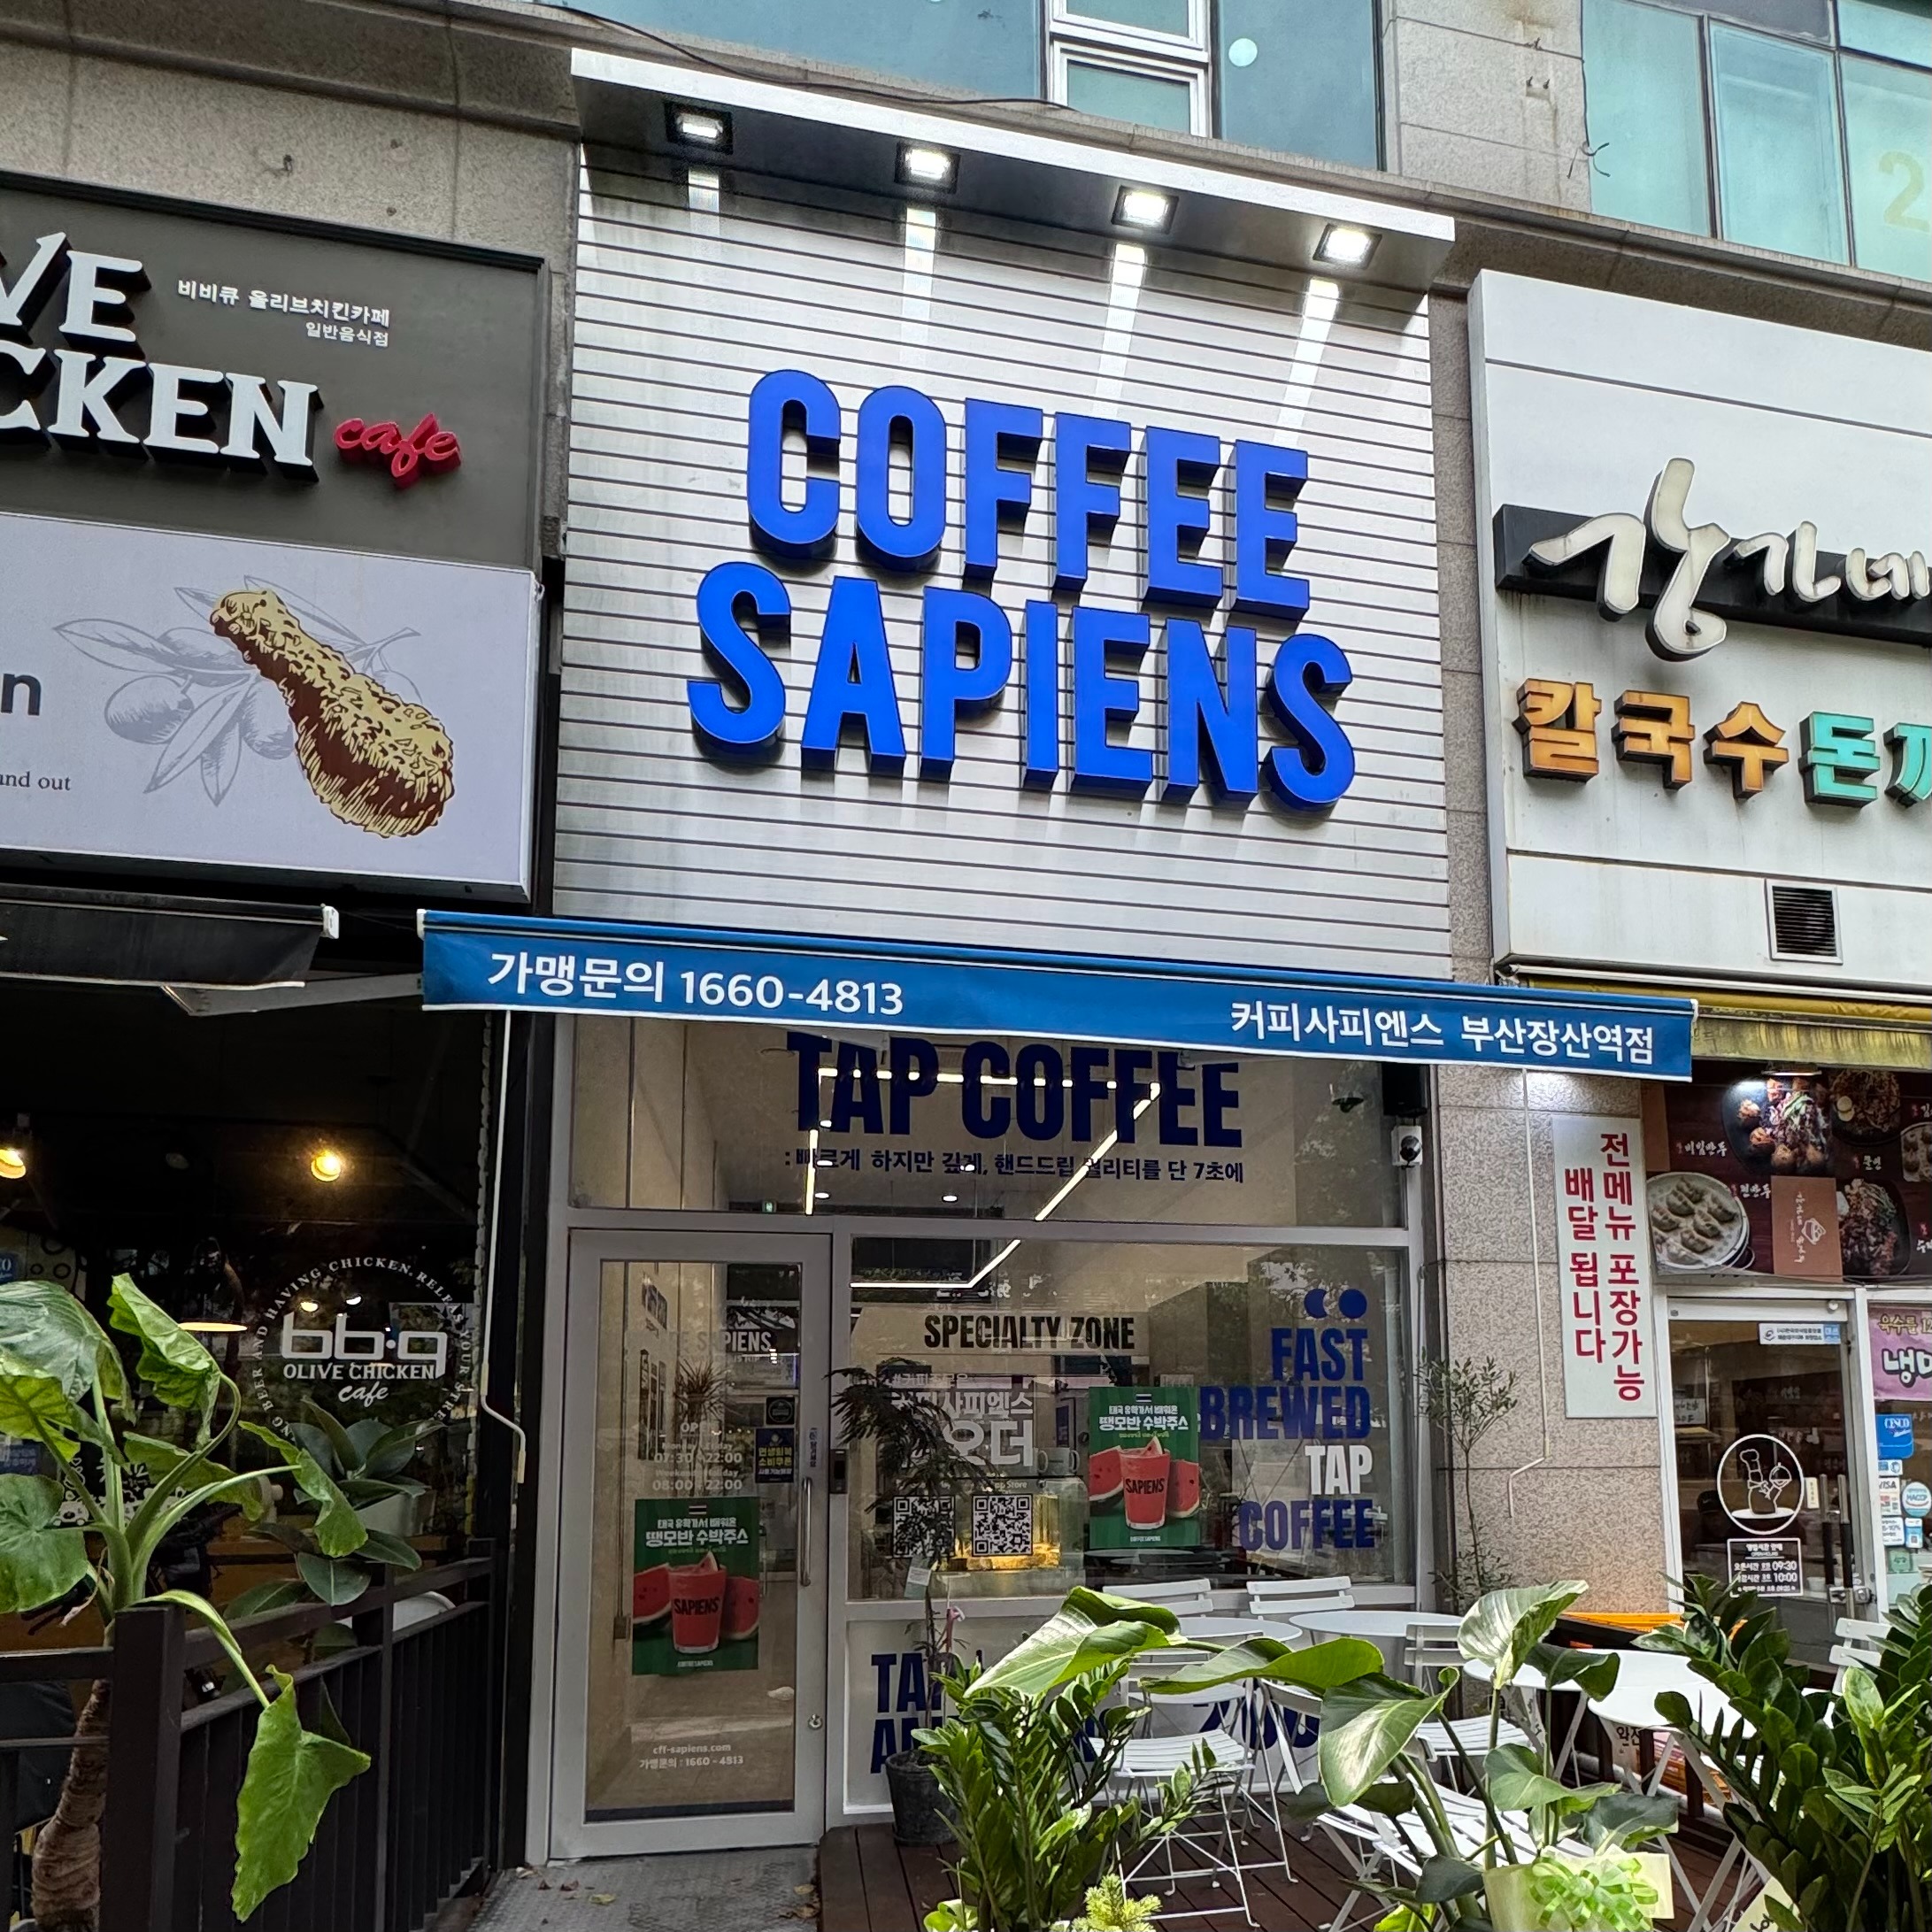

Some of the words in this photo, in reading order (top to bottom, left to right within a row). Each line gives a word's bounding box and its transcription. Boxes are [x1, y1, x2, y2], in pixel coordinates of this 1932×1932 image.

[1878, 150, 1929, 233] 2
[178, 280, 240, 306] 비비큐
[248, 289, 390, 327] 올리브치킨카페
[305, 321, 389, 348] 일반음식점
[333, 412, 462, 489] cafe
[747, 369, 1310, 620] COFFEE
[687, 561, 1355, 810] SAPIENS
[1516, 678, 1790, 798] 칼국수
[38, 776, 72, 790] out
[488, 951, 663, 1003] 가맹문의
[680, 971, 904, 1016] 1660-4813
[1231, 1000, 1443, 1048] 커피사피엔스
[1460, 1015, 1653, 1065] 부산장산역점
[787, 1031, 939, 1135] TAP
[962, 1041, 1243, 1148] COFFEE
[871, 1150, 935, 1174] 하지만
[995, 1153, 1074, 1177] 핸드드립
[1167, 1159, 1188, 1182] 단
[1195, 1161, 1243, 1183] 7초에
[1600, 1133, 1636, 1241] 전메뉴
[1564, 1167, 1598, 1241] 배달
[266, 1267, 322, 1320] HAVING
[1570, 1252, 1606, 1364] 됩니다
[252, 1325, 269, 1360] AND
[924, 1314, 1061, 1350] SPECIALTY
[1071, 1316, 1135, 1350] ZONE
[1608, 1253, 1644, 1401] 포장가능
[283, 1362, 344, 1380] OLIVE
[349, 1363, 435, 1380] CHICKEN
[1271, 1328, 1368, 1382] FAST
[252, 1367, 274, 1411] BEER
[338, 1382, 389, 1407] cafe
[1099, 1416, 1141, 1430] 땡모반
[1143, 1415, 1189, 1430] 수박주스
[1199, 1386, 1371, 1441] BREWED
[706, 1452, 743, 1463] 22:00
[1305, 1445, 1373, 1495] TAP
[1006, 1480, 1028, 1489] Store
[1125, 1478, 1165, 1494] SAPIENS
[646, 1530, 694, 1547] 땡모반
[696, 1528, 749, 1544] 수박주스
[1239, 1499, 1374, 1549] COFFEE
[1774, 1573, 1797, 1582] 10:00
[674, 1597, 720, 1615] SAPIENS
[686, 1757, 710, 1767] 1660
[720, 1755, 743, 1766] 4813
